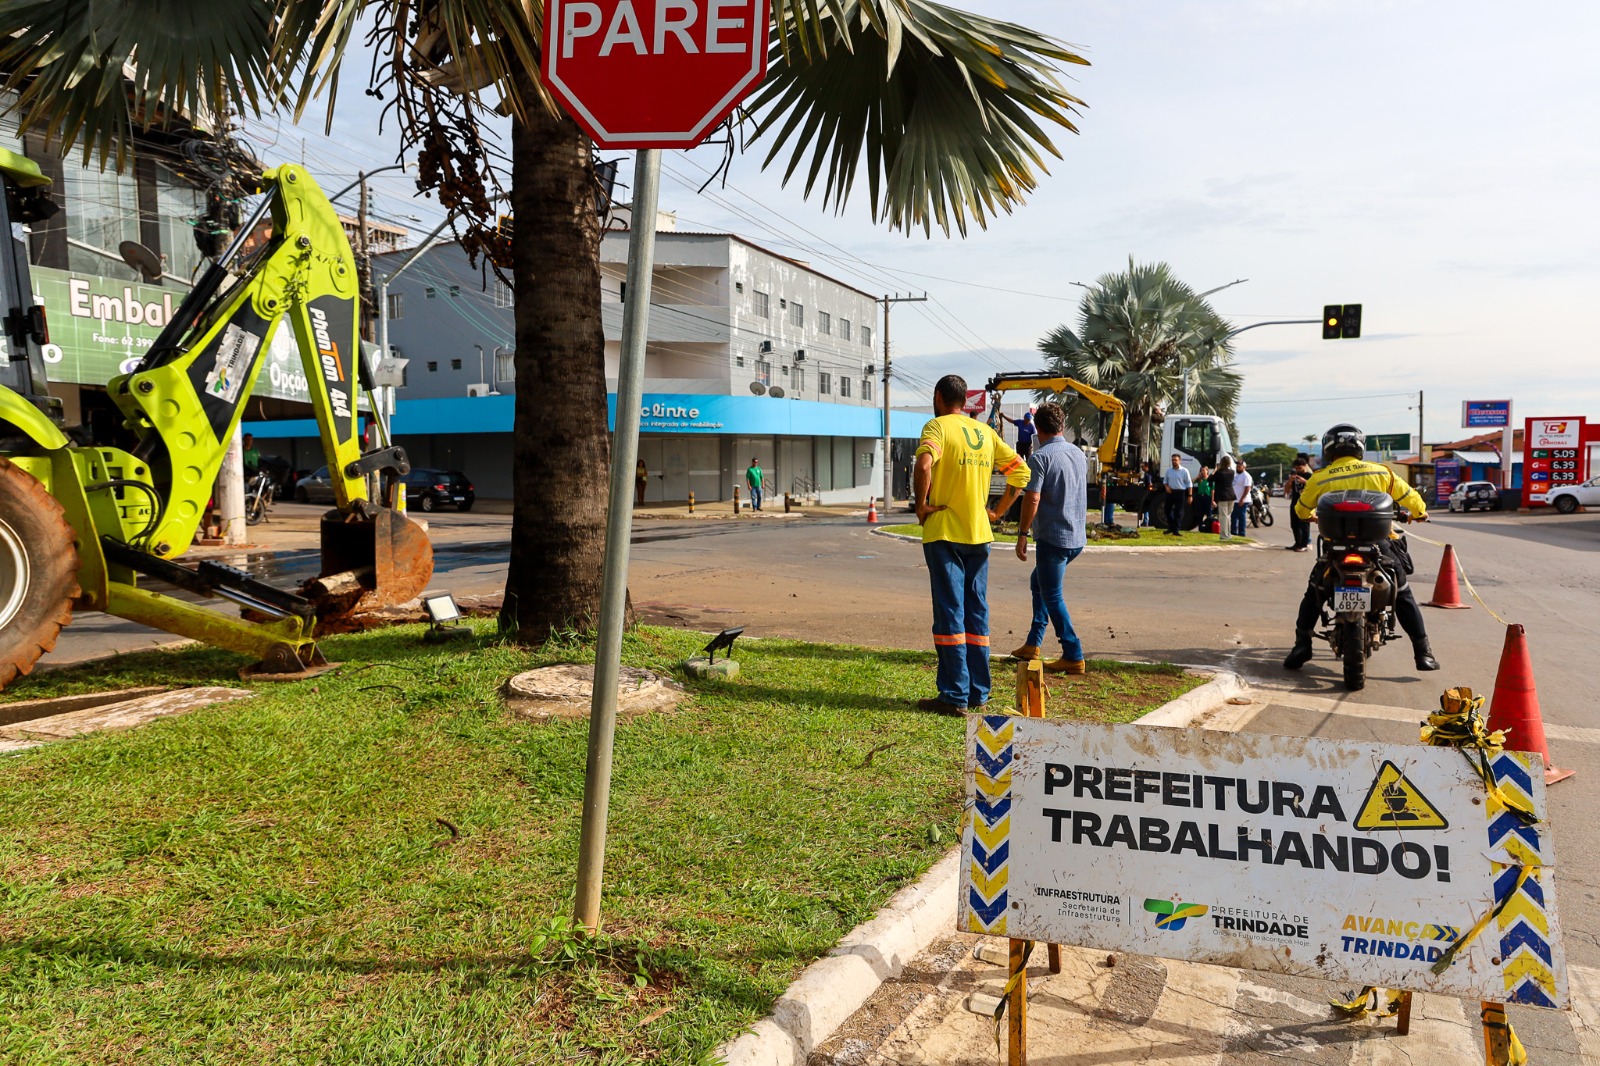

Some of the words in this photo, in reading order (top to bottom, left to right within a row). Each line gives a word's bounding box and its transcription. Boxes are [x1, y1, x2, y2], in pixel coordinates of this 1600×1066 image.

[562, 0, 748, 58] PARE
[227, 333, 246, 369] TRINDADE
[959, 458, 990, 468] URBAN
[1553, 450, 1575, 458] 5.09
[1553, 461, 1575, 469] 6.39
[1552, 472, 1575, 480] 6.39
[1339, 601, 1366, 610] 6B73
[1342, 592, 1362, 601] RCL
[1044, 763, 1347, 822] PREFEITURA
[1042, 808, 1451, 882] TRABALHANDO!
[1037, 887, 1120, 905] INFRAESTRUTURA
[1058, 909, 1120, 922] Infraestrutura
[1062, 902, 1107, 914] Secretaria
[1110, 907, 1120, 915] de
[1212, 906, 1287, 921] PREFEITURA
[1293, 915, 1309, 924] DE
[1212, 915, 1309, 939] TRINDADE
[1341, 914, 1435, 942] AVANÇA
[1341, 936, 1456, 965] TRINDAD
